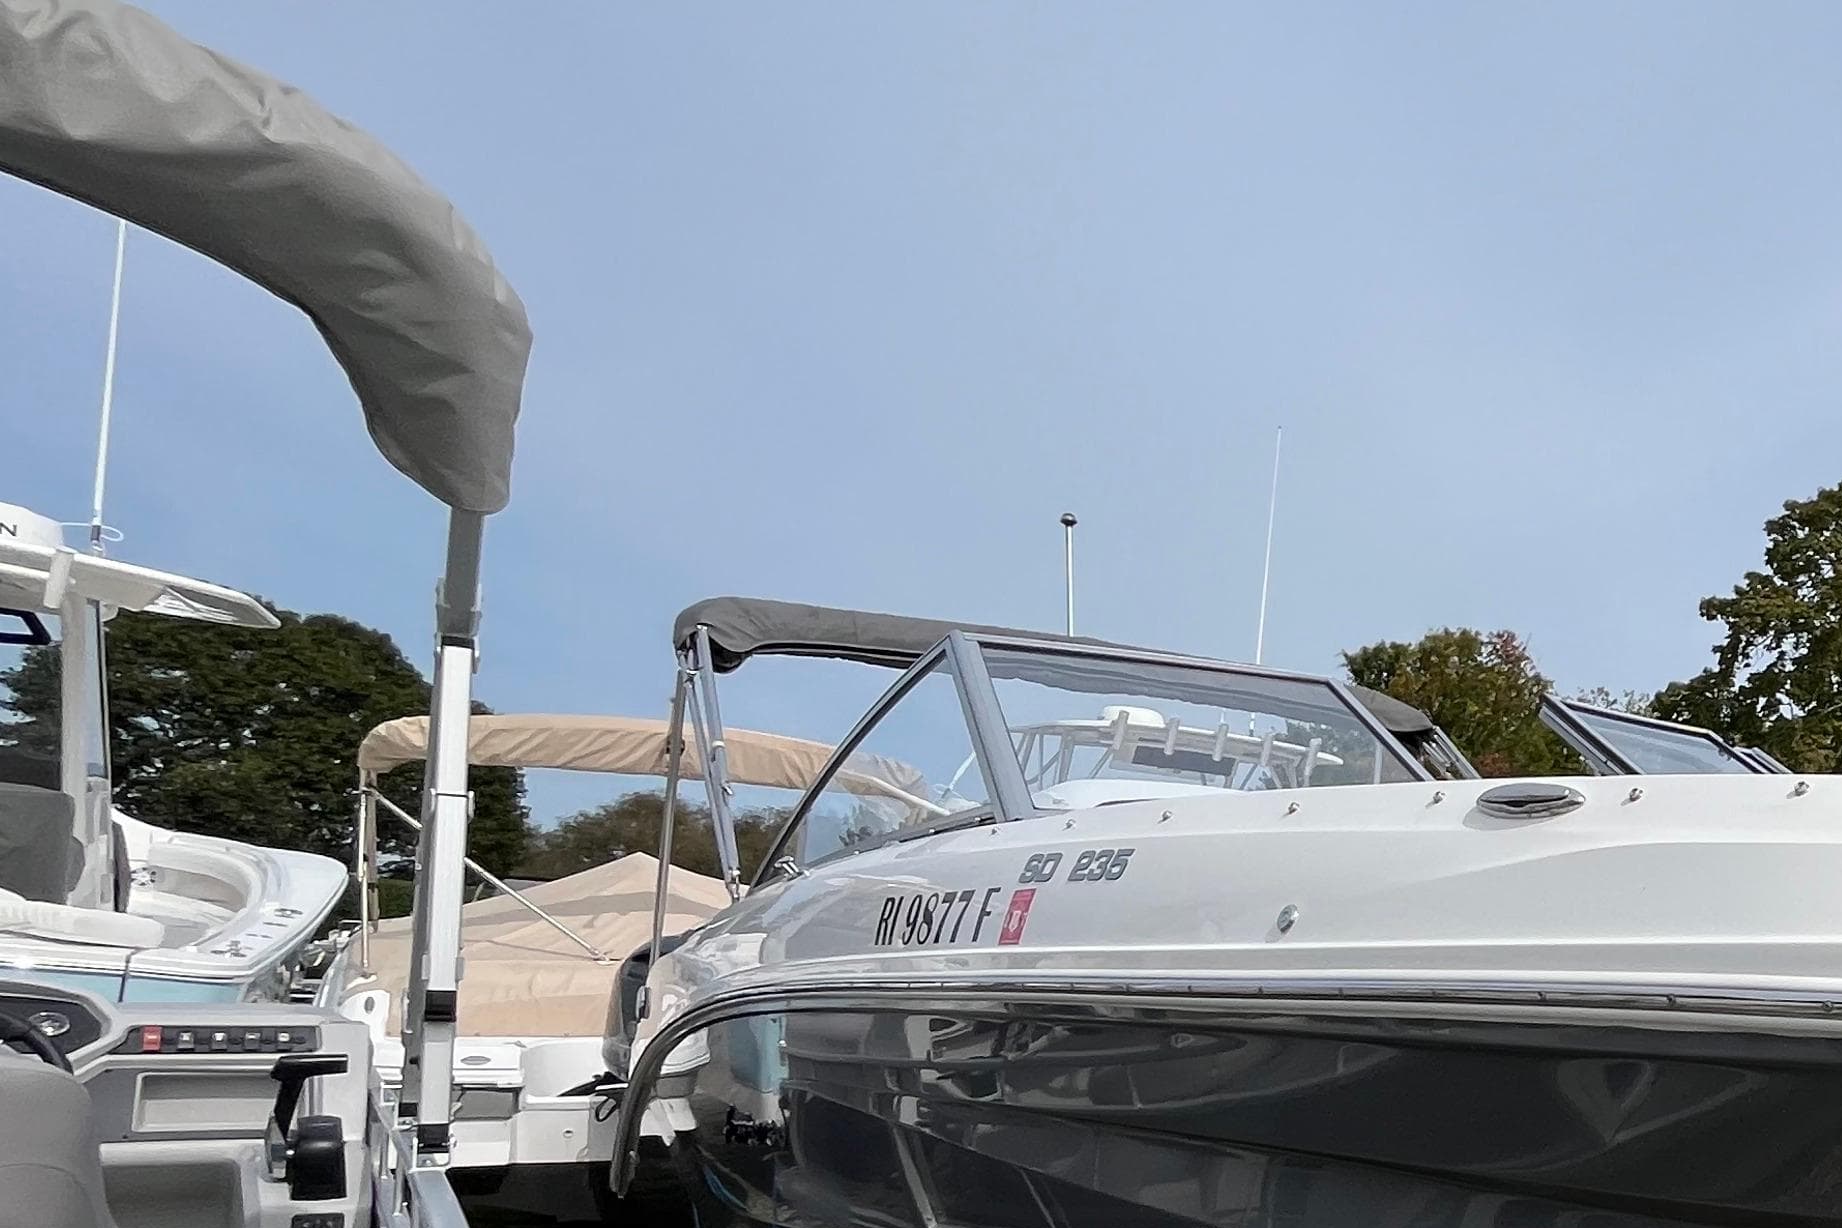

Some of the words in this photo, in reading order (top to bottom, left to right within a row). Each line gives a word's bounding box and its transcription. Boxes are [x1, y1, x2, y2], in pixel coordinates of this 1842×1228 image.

[1019, 853, 1063, 884] SD
[1068, 849, 1136, 882] 235
[874, 896, 903, 946] RI
[902, 889, 976, 945] 9877
[971, 887, 1002, 943] F
